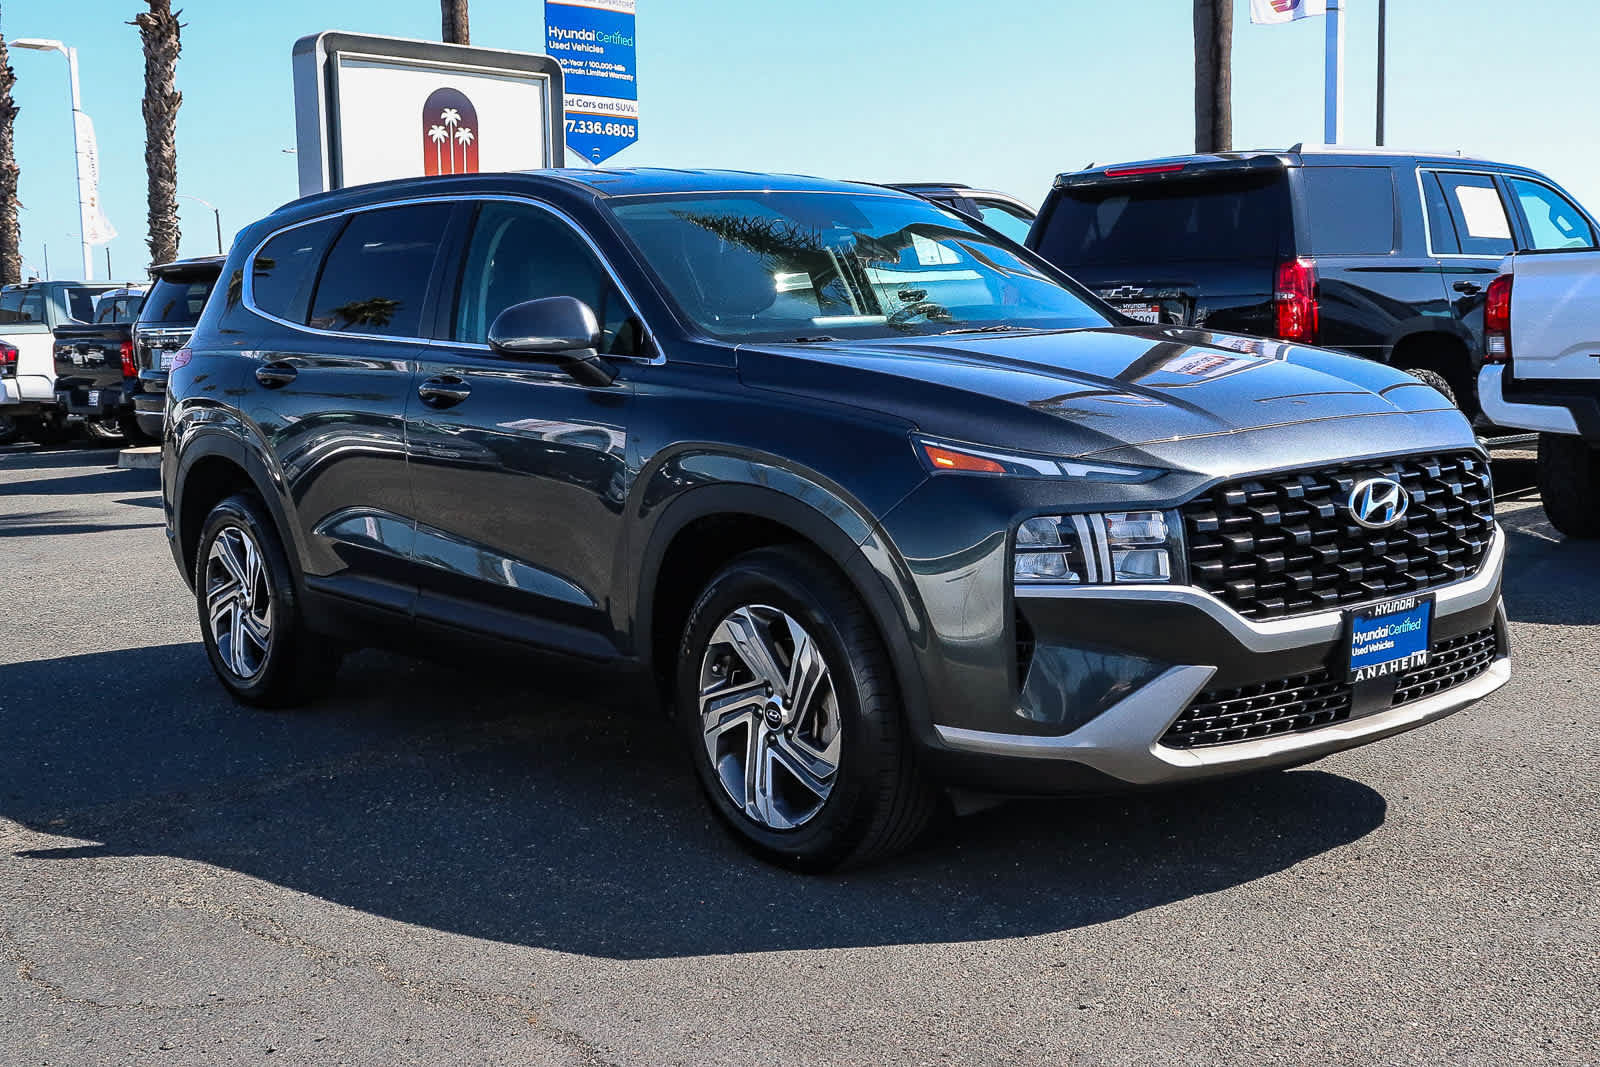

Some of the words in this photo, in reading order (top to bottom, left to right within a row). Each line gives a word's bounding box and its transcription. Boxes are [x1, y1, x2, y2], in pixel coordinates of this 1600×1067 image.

[548, 25, 596, 41] Hyundai
[596, 30, 633, 47] Certified
[548, 40, 570, 50] Used
[571, 42, 604, 54] Vehicles
[560, 58, 584, 67] 10-Year
[562, 67, 585, 76] ertrain
[586, 69, 609, 78] Limited
[609, 71, 634, 82] Warranty
[576, 99, 597, 108] Cars
[598, 102, 614, 111] and
[615, 102, 637, 113] SUVs.
[1375, 597, 1415, 616] HYUNDAI
[1352, 624, 1389, 645] Hyundai
[1388, 617, 1422, 636] Certified
[1352, 644, 1369, 657] Used
[1369, 640, 1395, 653] Vehicles
[1355, 652, 1427, 682] ANAHEIM
